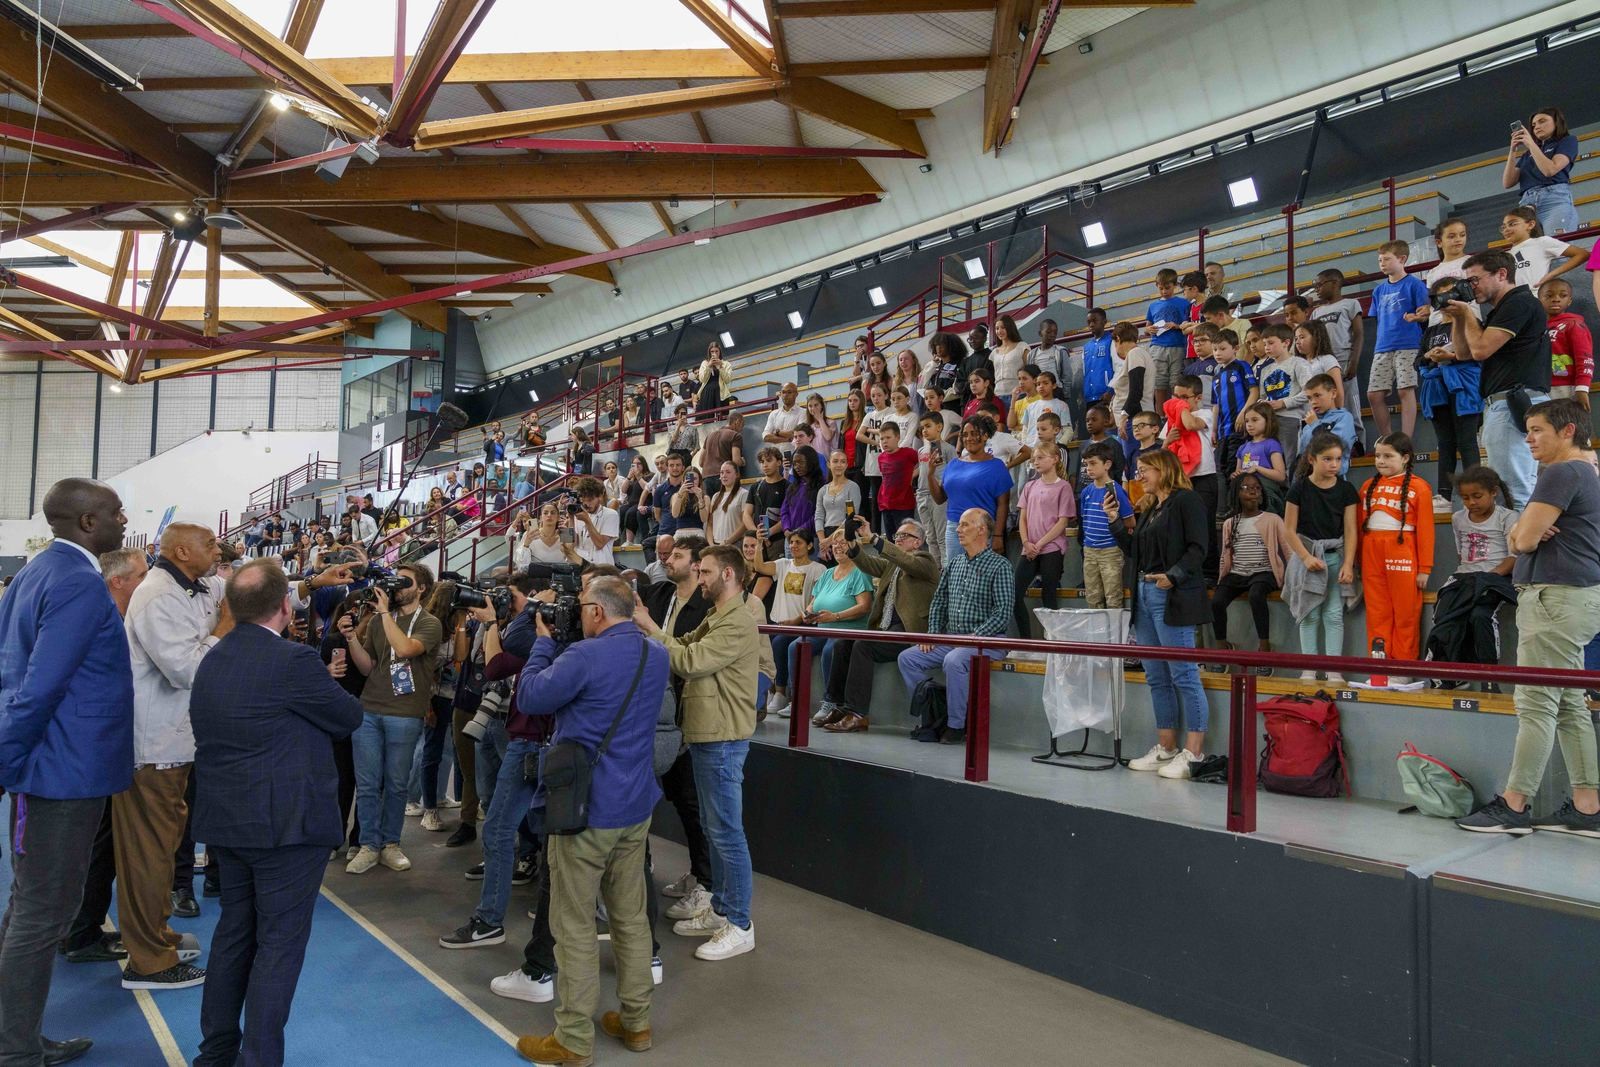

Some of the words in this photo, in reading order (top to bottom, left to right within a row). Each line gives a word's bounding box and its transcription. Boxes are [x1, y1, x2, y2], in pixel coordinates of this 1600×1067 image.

[1377, 485, 1416, 499] ruls
[1386, 563, 1412, 572] team
[1342, 691, 1353, 699] E5
[1460, 700, 1472, 709] E6
